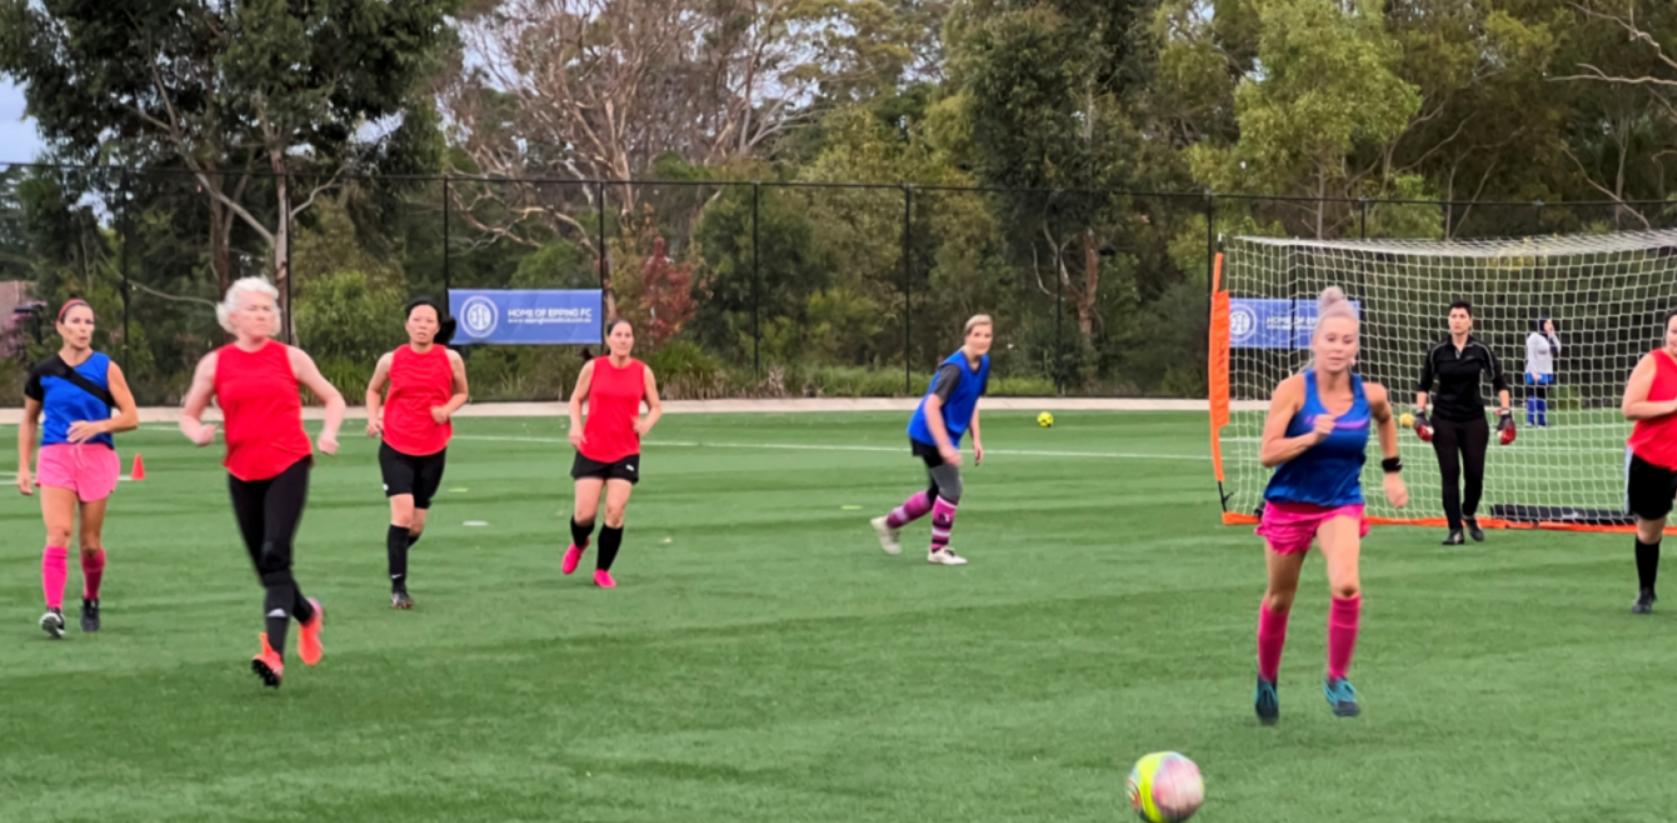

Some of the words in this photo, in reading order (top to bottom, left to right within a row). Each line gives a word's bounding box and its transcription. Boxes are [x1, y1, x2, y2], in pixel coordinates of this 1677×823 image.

[508, 308, 534, 318] HOME
[534, 308, 547, 318] OF
[580, 308, 593, 318] FC
